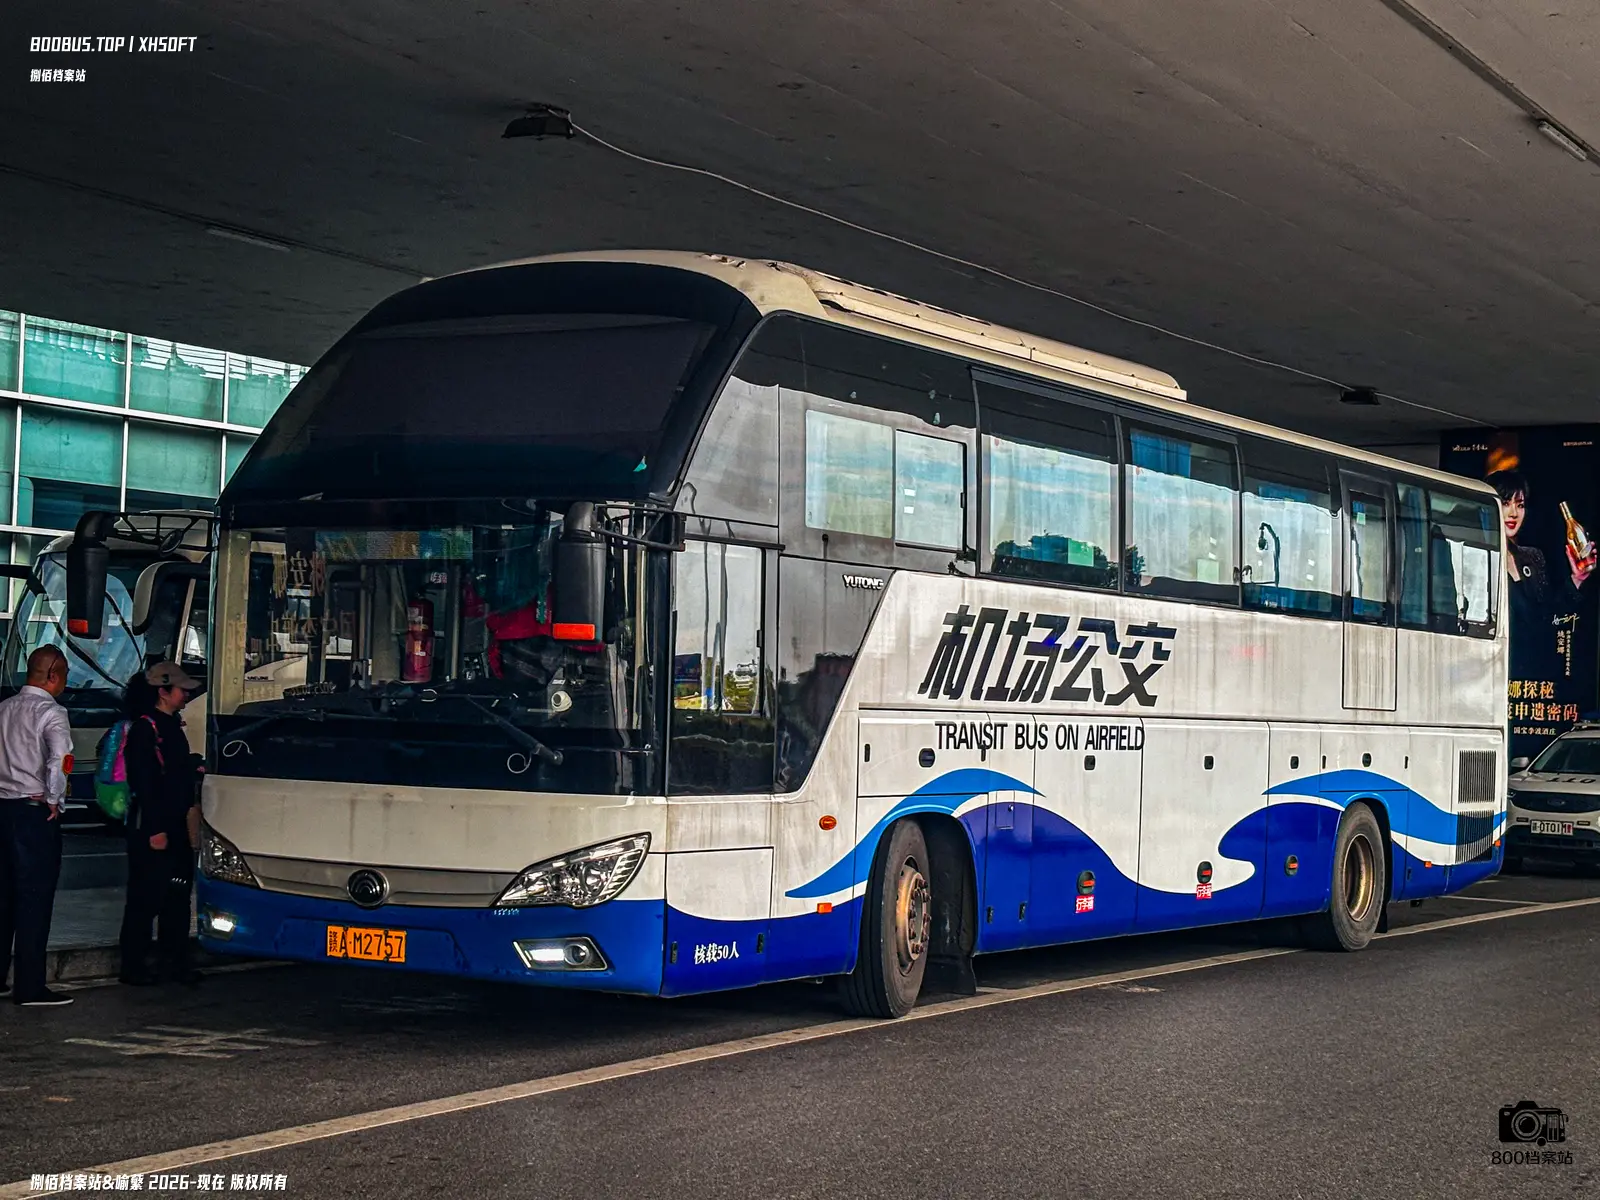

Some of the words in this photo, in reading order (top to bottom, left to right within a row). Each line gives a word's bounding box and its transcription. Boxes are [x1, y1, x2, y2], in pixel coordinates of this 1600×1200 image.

[842, 574, 884, 590] YUTONG
[918, 604, 1177, 707] 机场公交
[935, 720, 1008, 750] TRANSIT
[1014, 723, 1048, 750] BUS
[1055, 724, 1079, 750] ON
[1084, 724, 1145, 751] AIRFIELD
[694, 941, 739, 965] 核载50人
